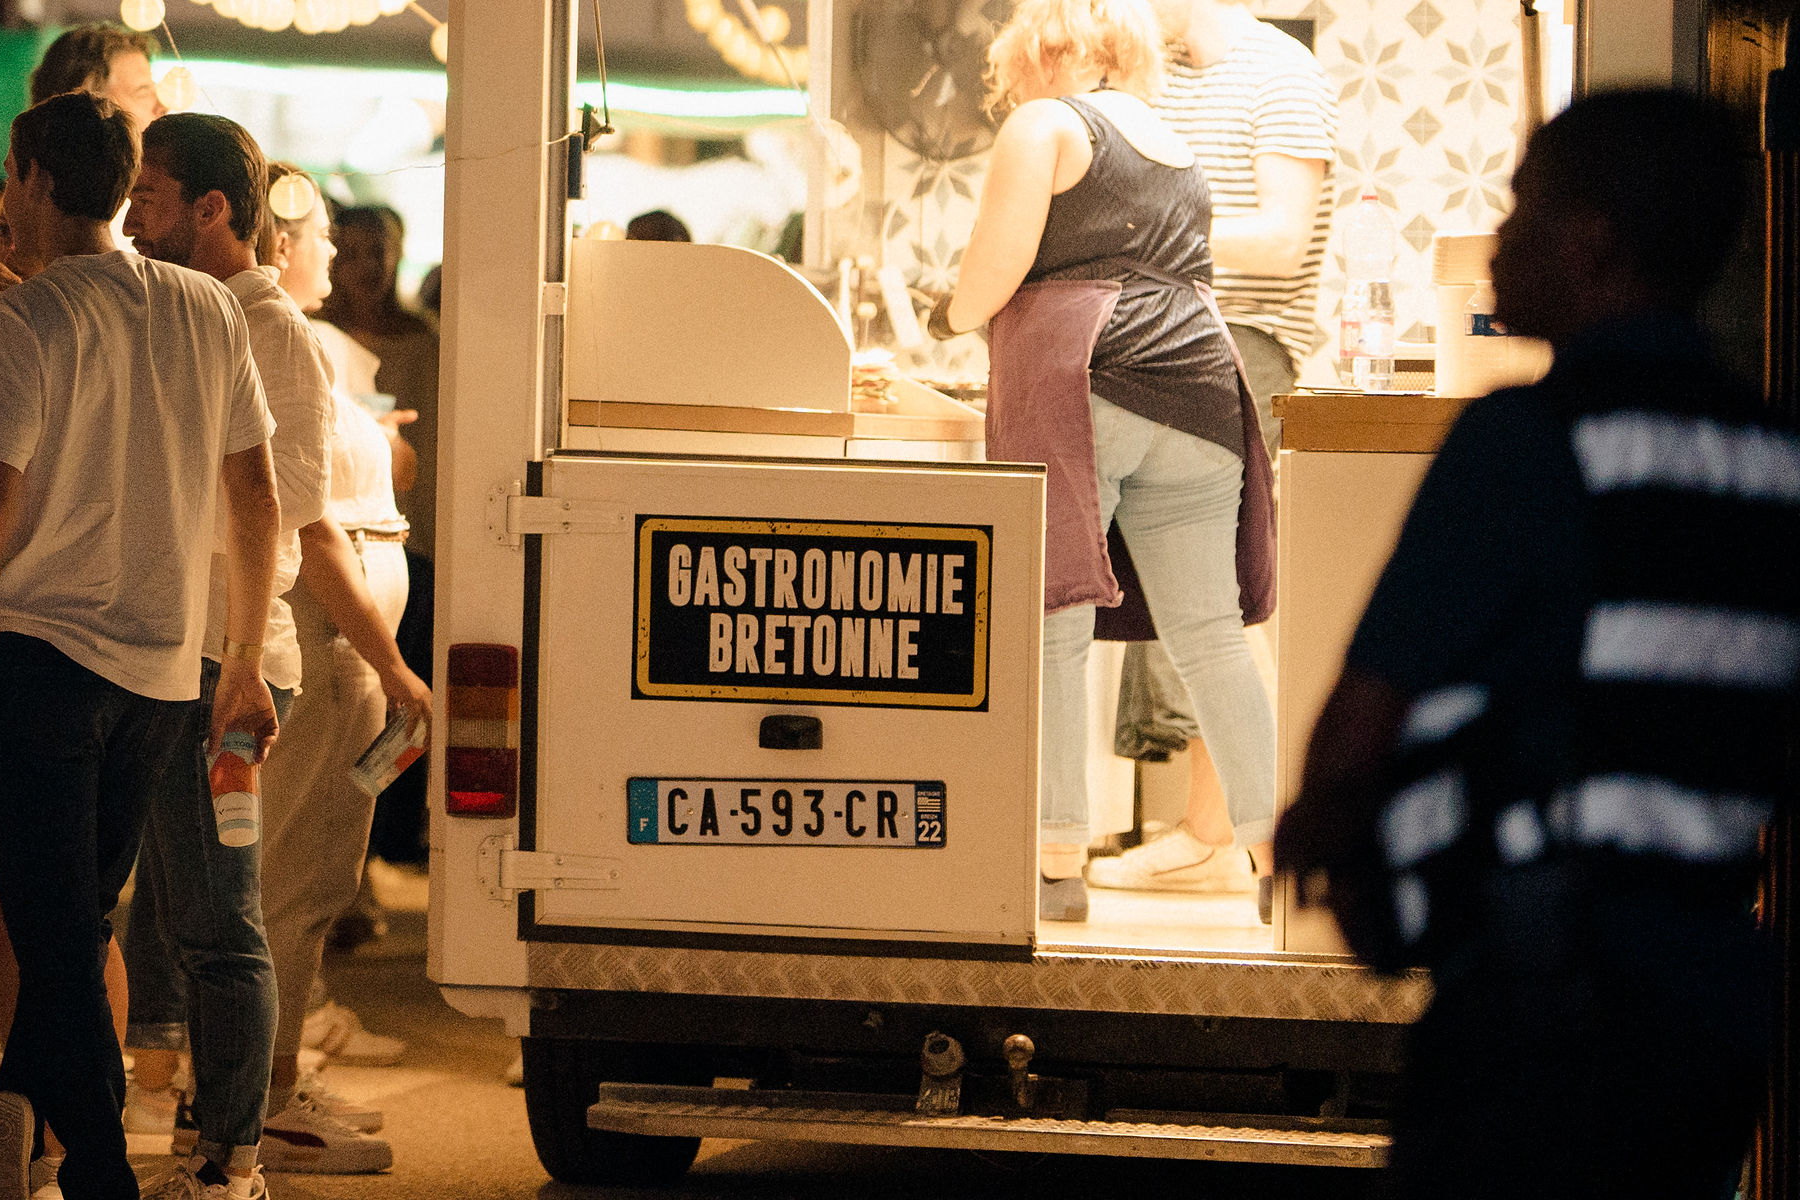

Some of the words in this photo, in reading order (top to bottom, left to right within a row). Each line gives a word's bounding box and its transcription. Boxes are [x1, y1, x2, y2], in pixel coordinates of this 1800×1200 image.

[669, 544, 964, 615] GASTRONOMIE
[709, 613, 919, 679] BRETONNE
[639, 818, 650, 832] F
[668, 788, 897, 838] CA-593-CR
[918, 820, 942, 842] 22
